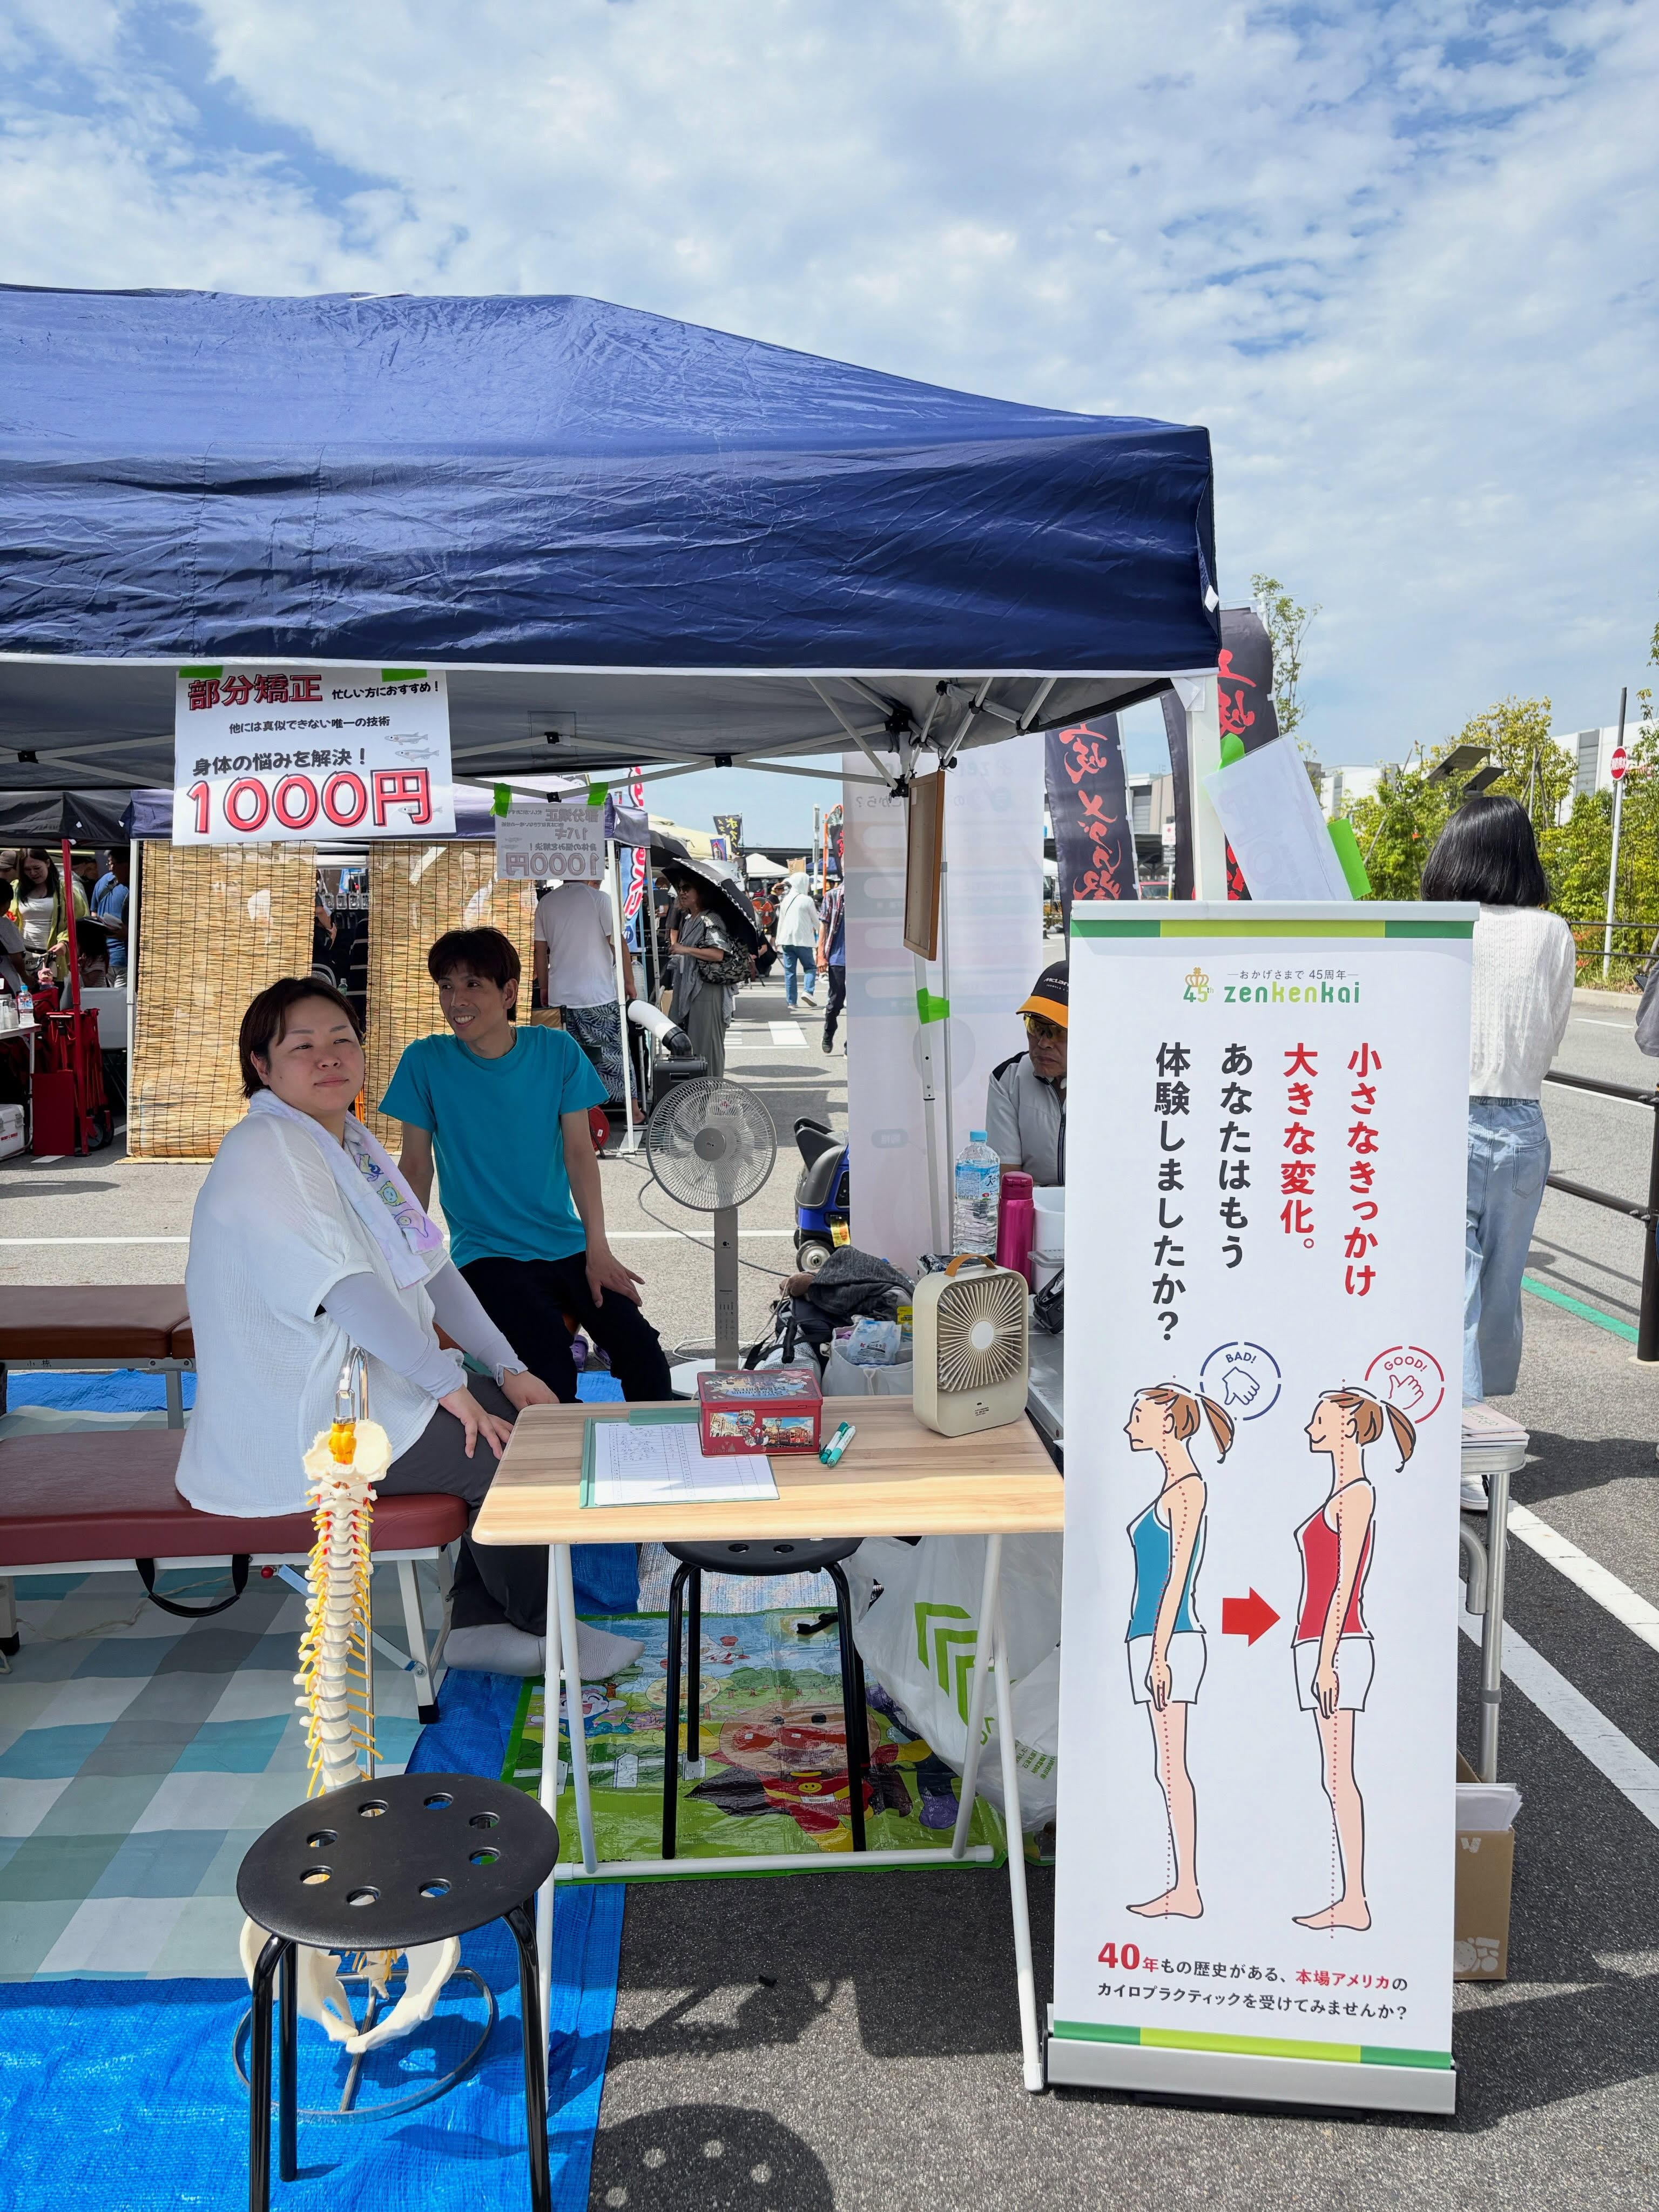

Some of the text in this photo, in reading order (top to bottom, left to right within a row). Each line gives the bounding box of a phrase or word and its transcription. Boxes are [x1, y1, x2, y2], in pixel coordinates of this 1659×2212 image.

[188, 674, 439, 711] 部分矯正 忙しい方におすすめ！
[229, 716, 390, 735] 他には真似できない唯一の技術
[192, 748, 366, 775] 身体の悩みを解決！
[186, 767, 431, 834] 1000円
[1224, 981, 1359, 1003] zenkenkai
[1240, 969, 1347, 980] おかげさまで 45周年
[1218, 1043, 1252, 1269] あなたはもう
[1280, 1042, 1319, 1249] 大きな変化。
[1344, 1042, 1382, 1297] 小さなきっかけ
[1151, 1042, 1191, 1340] 体験しましたか？
[1225, 1351, 1257, 1365] BAD!
[1384, 1356, 1427, 1372] GOOD!
[1097, 1942, 1407, 1992] 40年もの歴史がある、本場アメリカの
[1097, 1981, 1407, 2020] カイロプラクティックを受けてみませんか？
